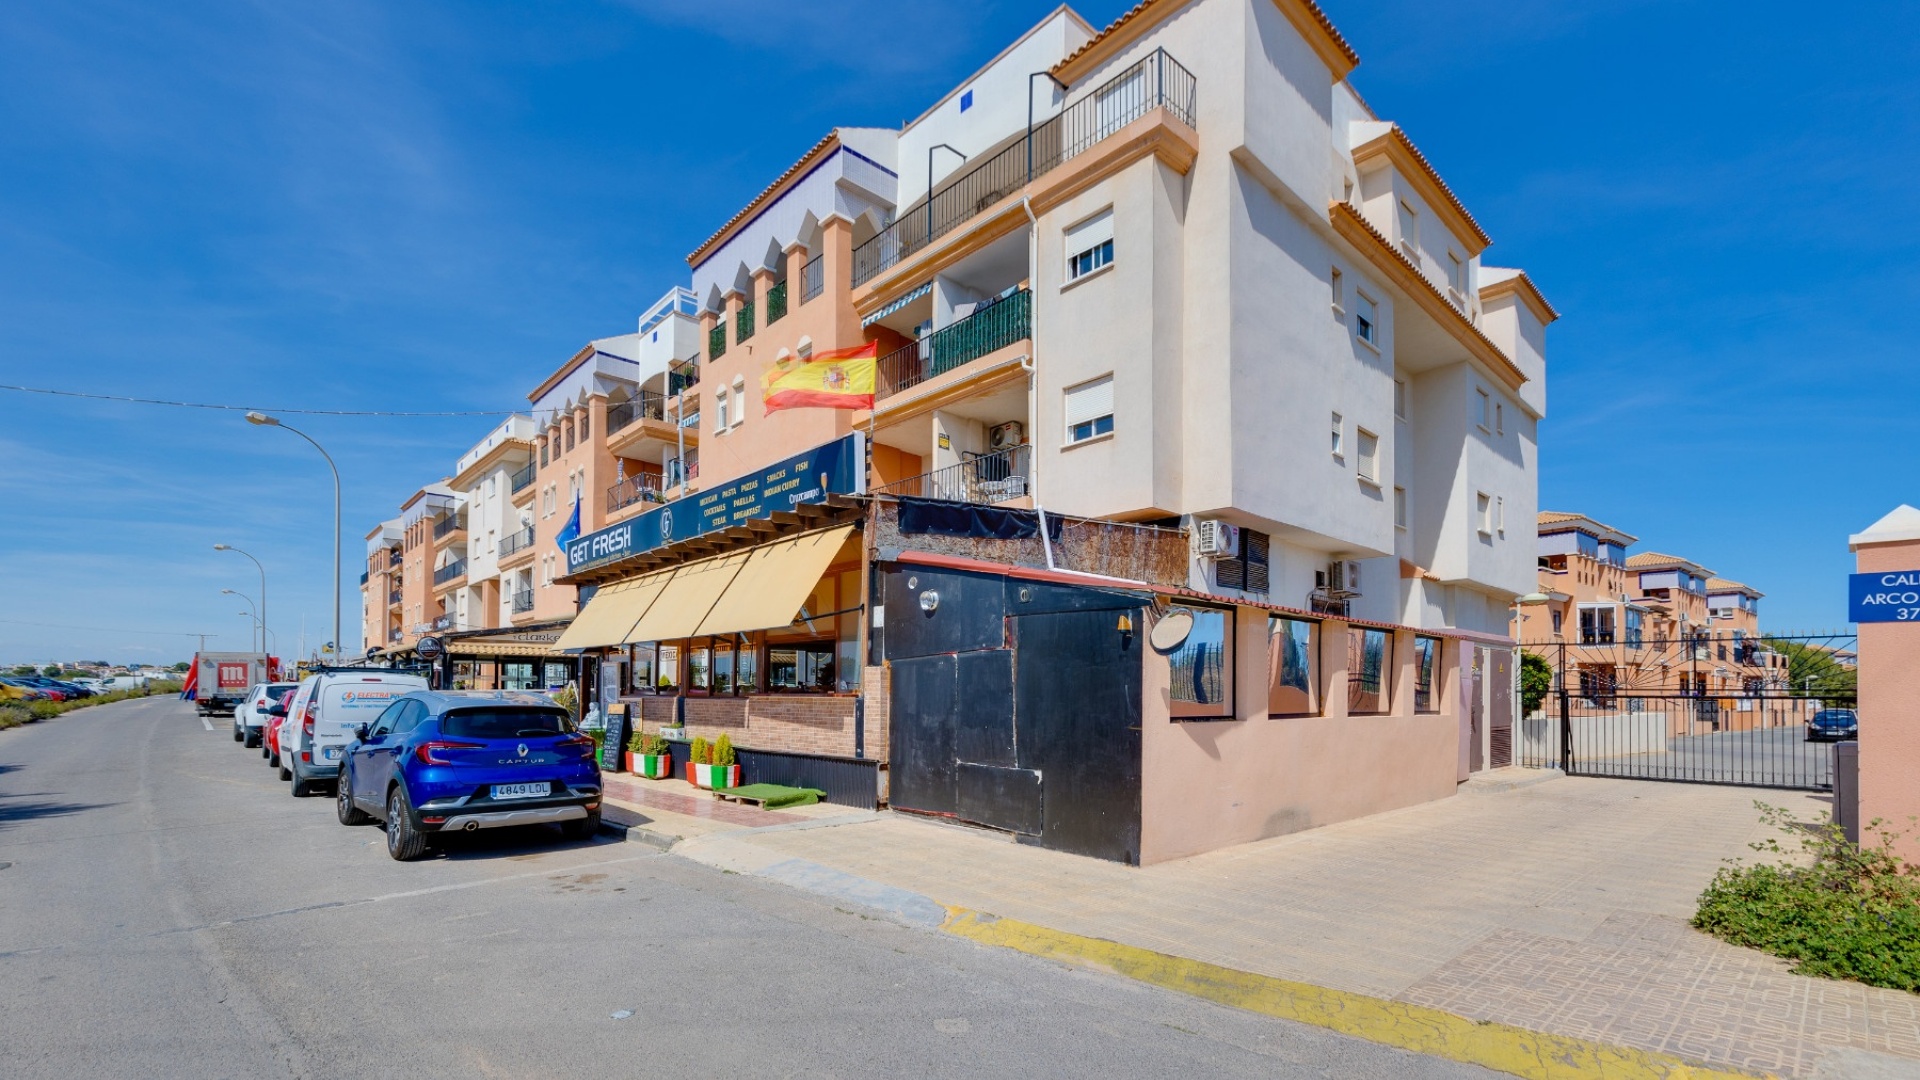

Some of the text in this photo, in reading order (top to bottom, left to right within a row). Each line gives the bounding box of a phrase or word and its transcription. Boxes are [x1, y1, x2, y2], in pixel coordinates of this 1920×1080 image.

[699, 461, 809, 506] MEXICAN PASTA PIZZAS SNACKS FISH
[703, 504, 726, 517] COCKTAILS
[764, 485, 781, 498] INDIAN
[782, 478, 800, 491] CURRY
[789, 487, 820, 504] Cruzcampo
[712, 505, 762, 526] STEAK BREAKFAST
[570, 525, 632, 566] GET FRESH
[1881, 574, 1920, 587] CAL
[1862, 591, 1920, 605] ARCO
[1897, 607, 1920, 620] 37
[499, 783, 548, 795] 4849 LDL
